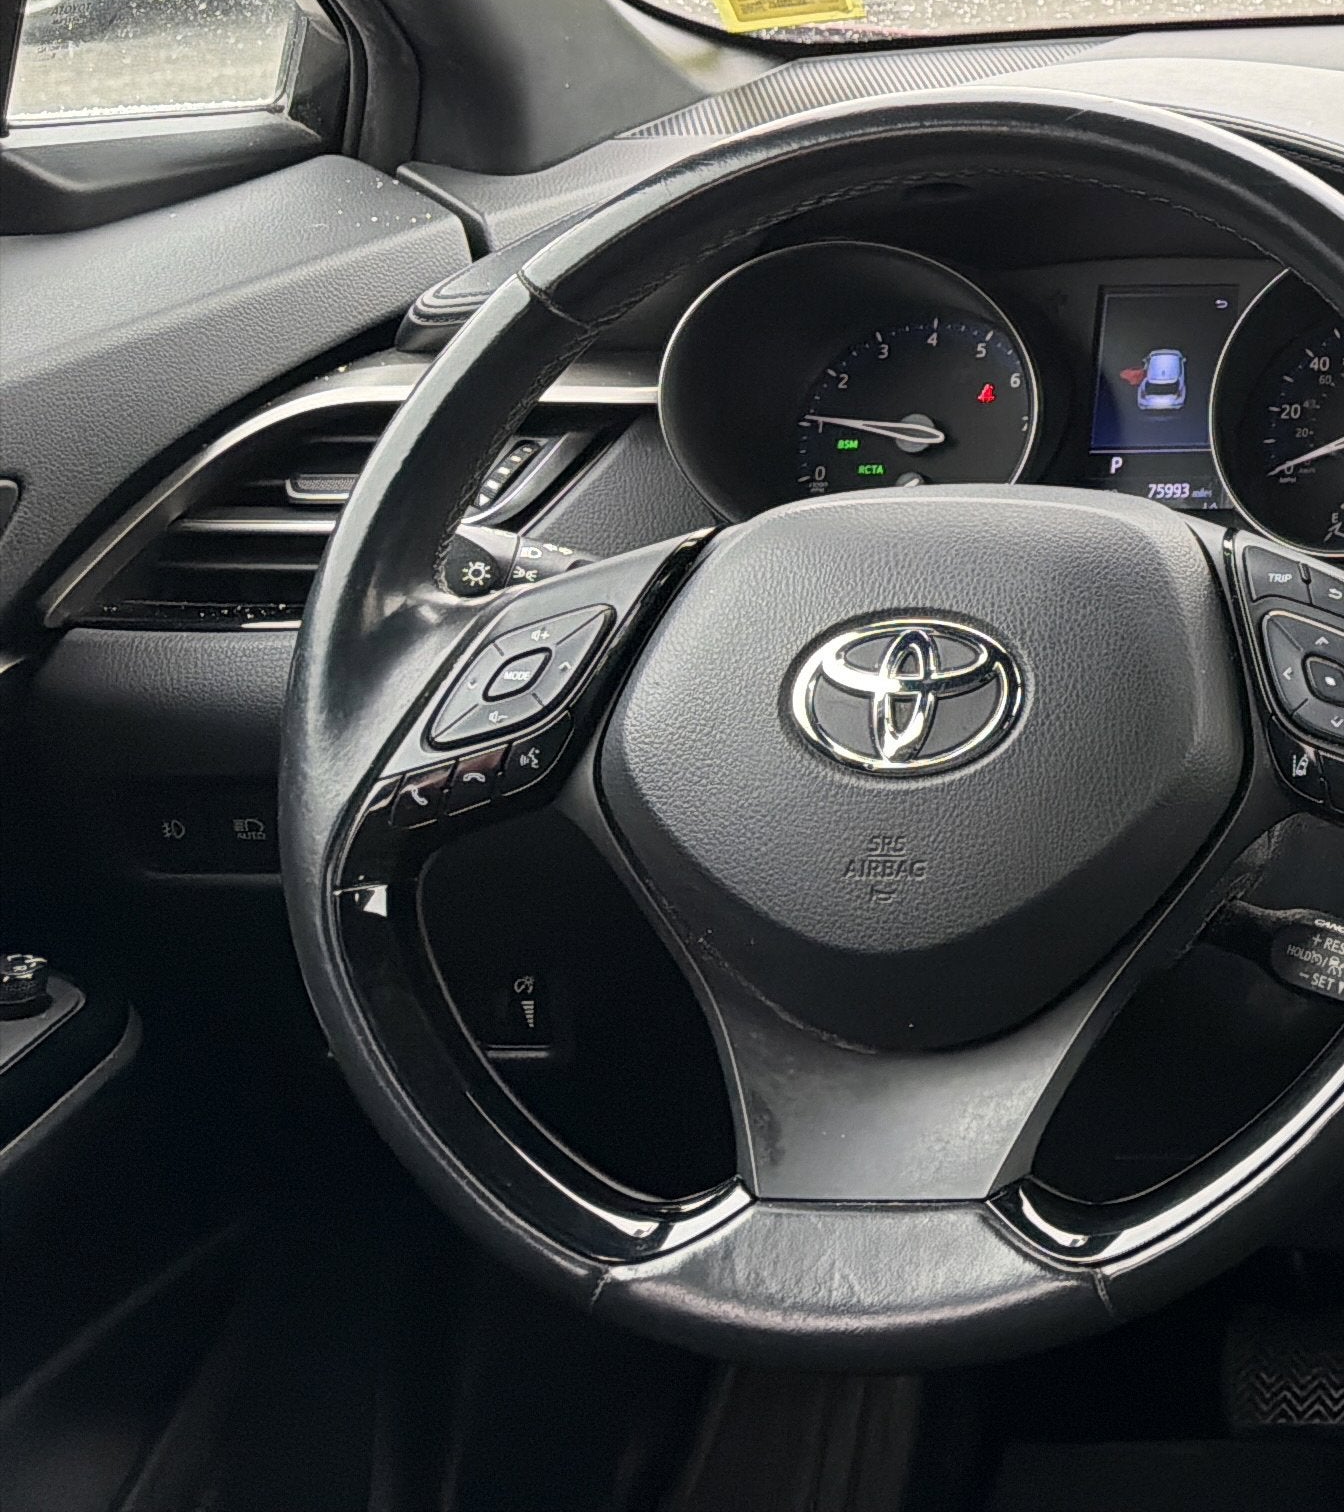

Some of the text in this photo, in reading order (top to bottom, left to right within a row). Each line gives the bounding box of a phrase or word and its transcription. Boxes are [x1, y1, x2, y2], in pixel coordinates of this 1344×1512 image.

[926, 333, 939, 347] 4
[877, 344, 889, 359] 3
[975, 343, 988, 358] 5
[1310, 356, 1330, 372] 40
[837, 374, 849, 389] 2
[1010, 373, 1021, 388] 6
[1318, 375, 1332, 385] 60
[1280, 404, 1301, 420] 20
[1296, 428, 1309, 438] 20
[837, 439, 859, 450] BSM
[814, 465, 826, 481] 0
[858, 464, 885, 476] RCTA
[1109, 456, 1123, 475] P
[1147, 483, 1190, 499] 75993
[1331, 512, 1339, 523] E
[1268, 572, 1293, 584] TRIP
[503, 671, 531, 682] MODE
[867, 835, 907, 855] SRS
[843, 859, 929, 881] AIRBAG
[1287, 944, 1312, 962] HOLD
[1311, 972, 1336, 990] SET
